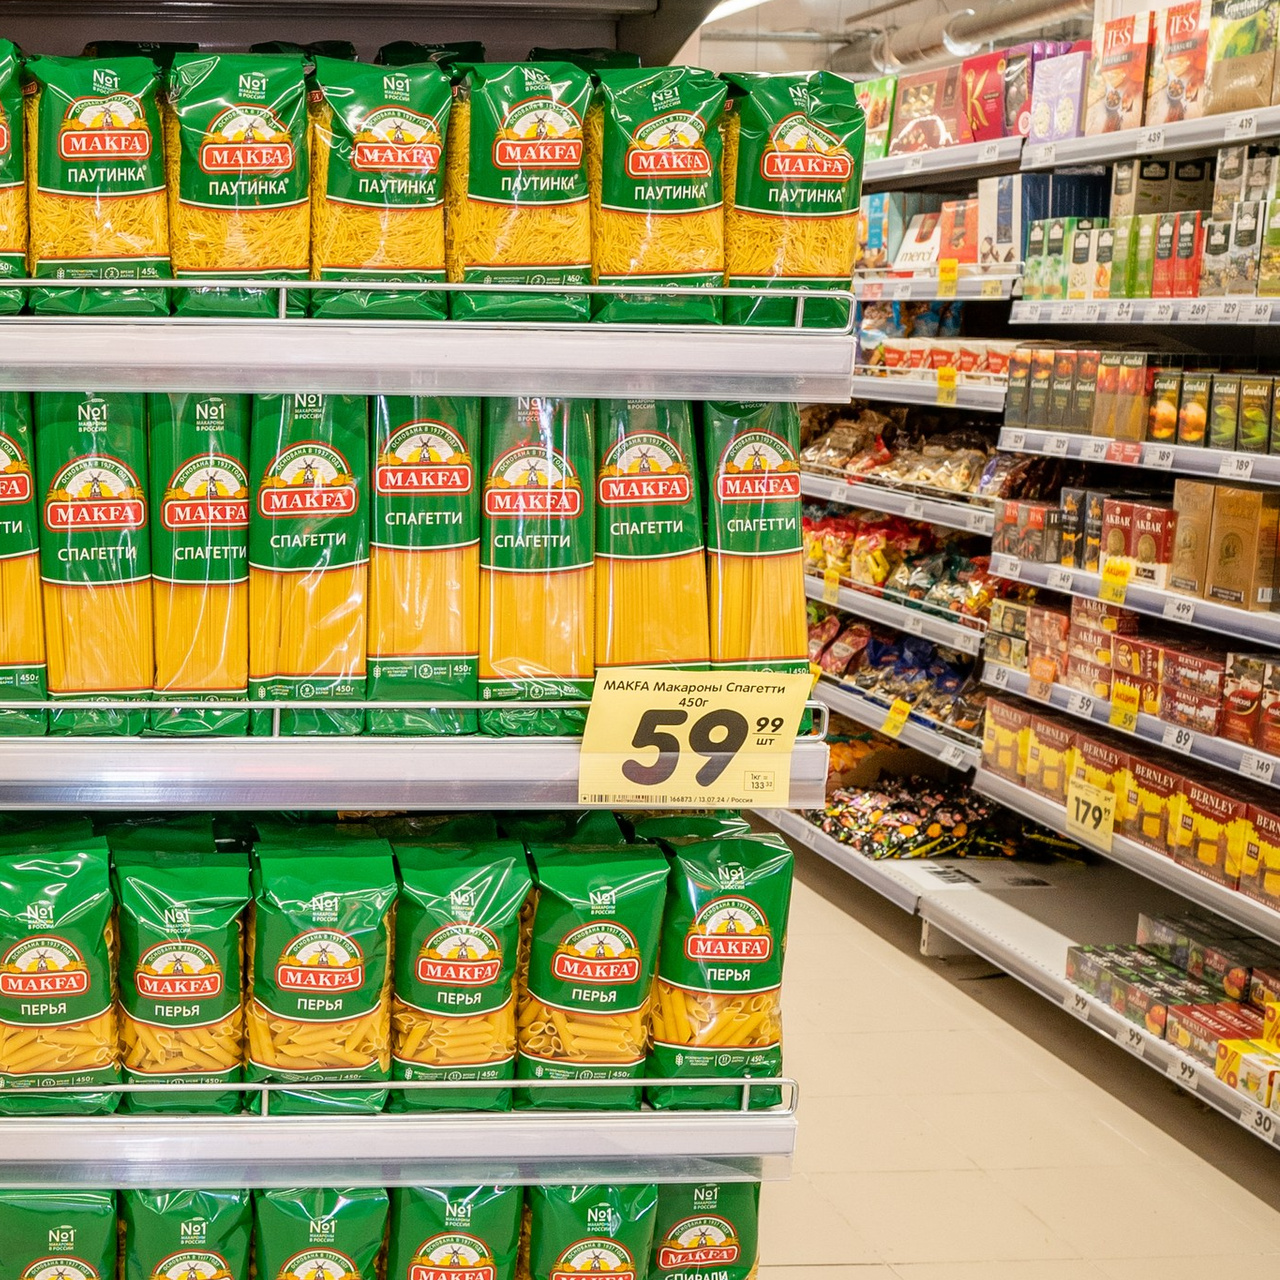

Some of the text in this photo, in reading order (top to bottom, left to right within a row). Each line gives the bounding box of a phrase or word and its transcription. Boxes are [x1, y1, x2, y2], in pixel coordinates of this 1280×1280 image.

[1170, 11, 1196, 36] TESS
[1107, 25, 1131, 49] TESS
[1148, 132, 1161, 142] 439
[503, 145, 578, 162] MAKFA
[385, 471, 462, 488] MAKFA
[386, 511, 462, 526] СПАГЕТТИ
[1105, 514, 1131, 526] AKBAR
[1135, 520, 1162, 533] AKBAR
[1176, 603, 1191, 614] 499
[604, 681, 785, 694] MAKFA Макароны Спагетти
[679, 698, 708, 707] 450г
[1079, 698, 1091, 711] 59
[1176, 731, 1190, 744] 89
[622, 709, 783, 787] 59 99
[1256, 760, 1270, 772] 149
[1135, 764, 1176, 789] BERNLEY
[1190, 787, 1235, 814] BERNLEY
[1075, 796, 1103, 830] 179
[695, 938, 762, 956] MAKFA
[706, 968, 750, 982] ПЕРЬЯ
[6, 975, 76, 992] MAKFA
[20, 1001, 66, 1016] ПЕРЬЯ
